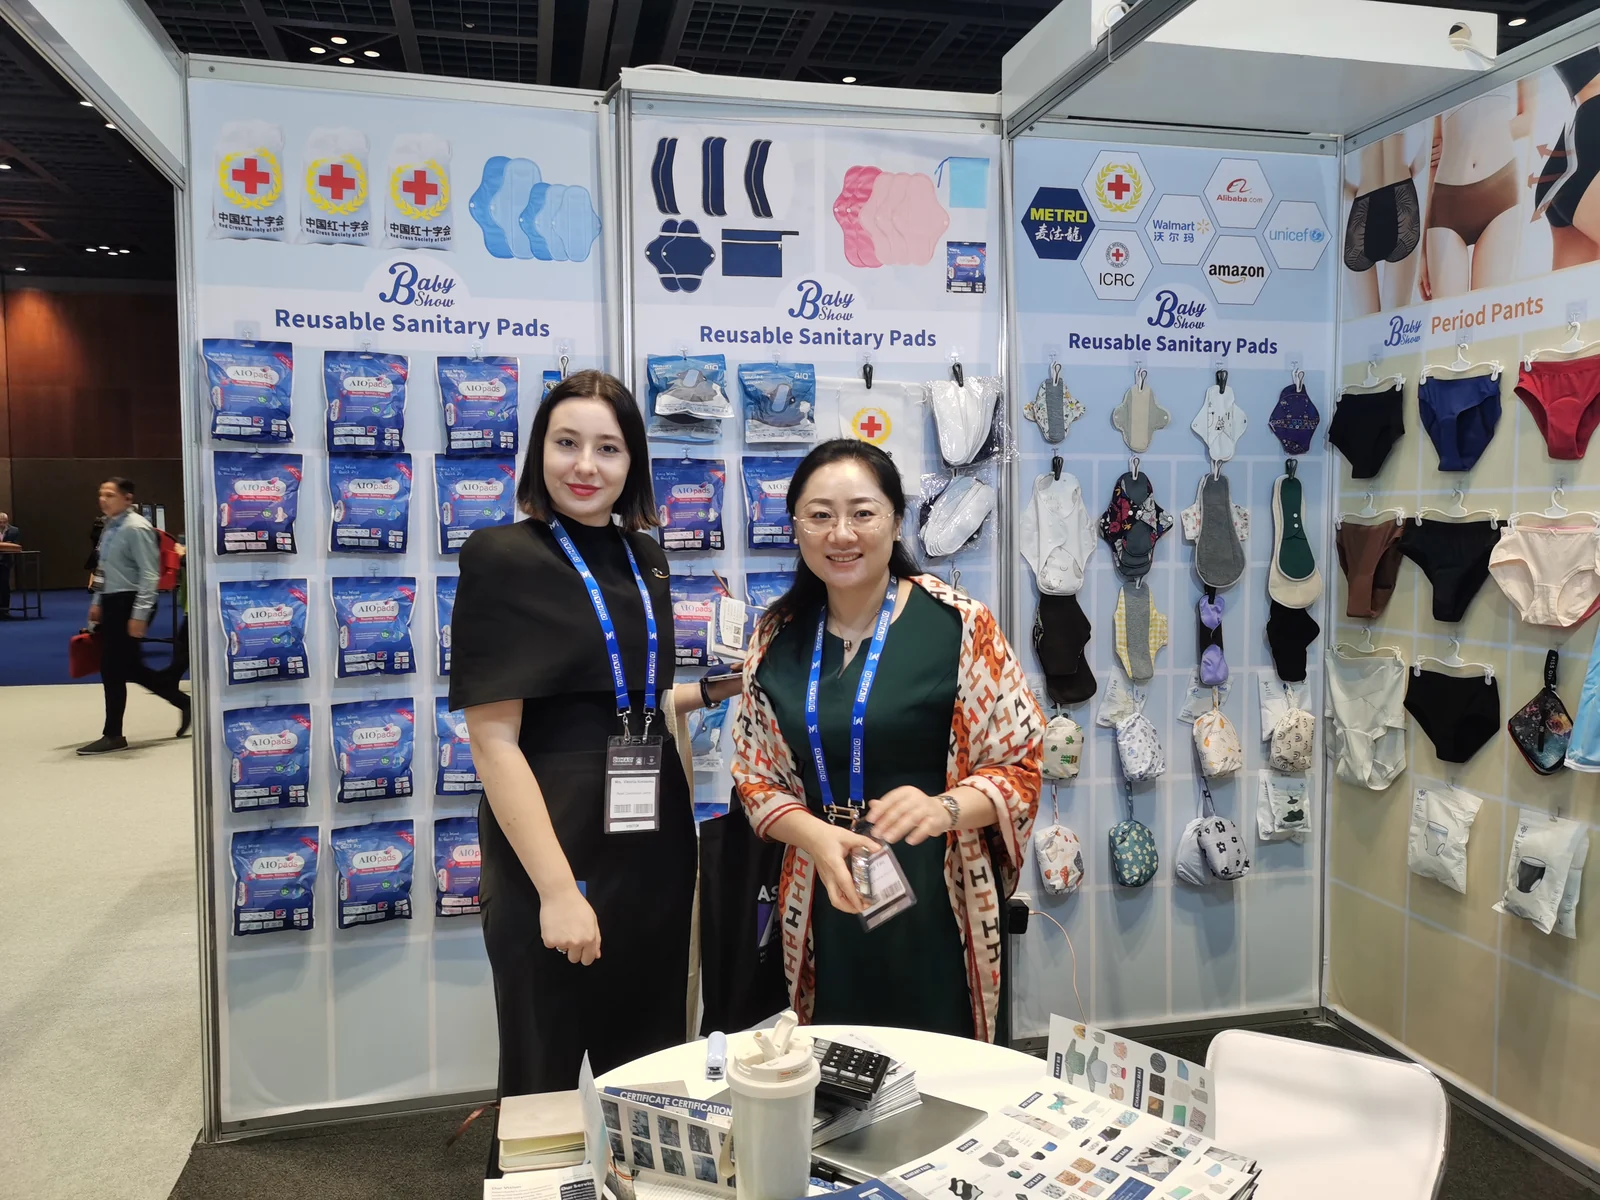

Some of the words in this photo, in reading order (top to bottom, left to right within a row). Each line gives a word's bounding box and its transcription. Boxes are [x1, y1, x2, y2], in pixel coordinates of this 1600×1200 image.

[219, 212, 284, 227] 中国红十字会
[306, 217, 369, 232] 中国红十字会
[1030, 207, 1088, 223] METRO
[1152, 219, 1195, 231] Walmart
[390, 222, 451, 237] 中国红十字会
[1153, 231, 1195, 244] 沃尔玛
[1269, 228, 1309, 242] unicef
[378, 261, 457, 307] Baby
[1099, 272, 1135, 287] ICRC
[1208, 264, 1265, 278] amazon
[414, 291, 456, 308] Show
[788, 279, 855, 320] Baby
[1147, 289, 1207, 328] Baby
[275, 308, 386, 332] Reusable
[392, 313, 490, 339] Sanitary
[497, 318, 550, 337] Pads
[818, 306, 854, 321] Show
[1173, 315, 1206, 329] Show
[1431, 305, 1486, 335] Period
[1491, 297, 1544, 322] Pants
[700, 325, 793, 345] Reusable
[799, 328, 884, 351] Sanitary
[889, 330, 937, 347] Pads
[1384, 315, 1422, 347] Baby
[1400, 335, 1421, 346] Show
[1069, 333, 1151, 350] Reusable
[1156, 335, 1230, 356] Sanitary
[1236, 337, 1278, 355] Pads
[560, 536, 581, 563] DIHAD
[591, 589, 608, 621] DIHAD
[875, 610, 890, 641] DIHAD
[611, 653, 624, 687] DIHAD
[648, 651, 656, 684] DIHAD
[808, 680, 818, 713] DIHAD
[857, 670, 873, 703] DIHAD
[814, 747, 827, 782] DIHAD
[853, 738, 861, 773] DIHAD
[620, 1091, 670, 1106] CERTIFICATE
[671, 1098, 733, 1116] CERTIFICATION
